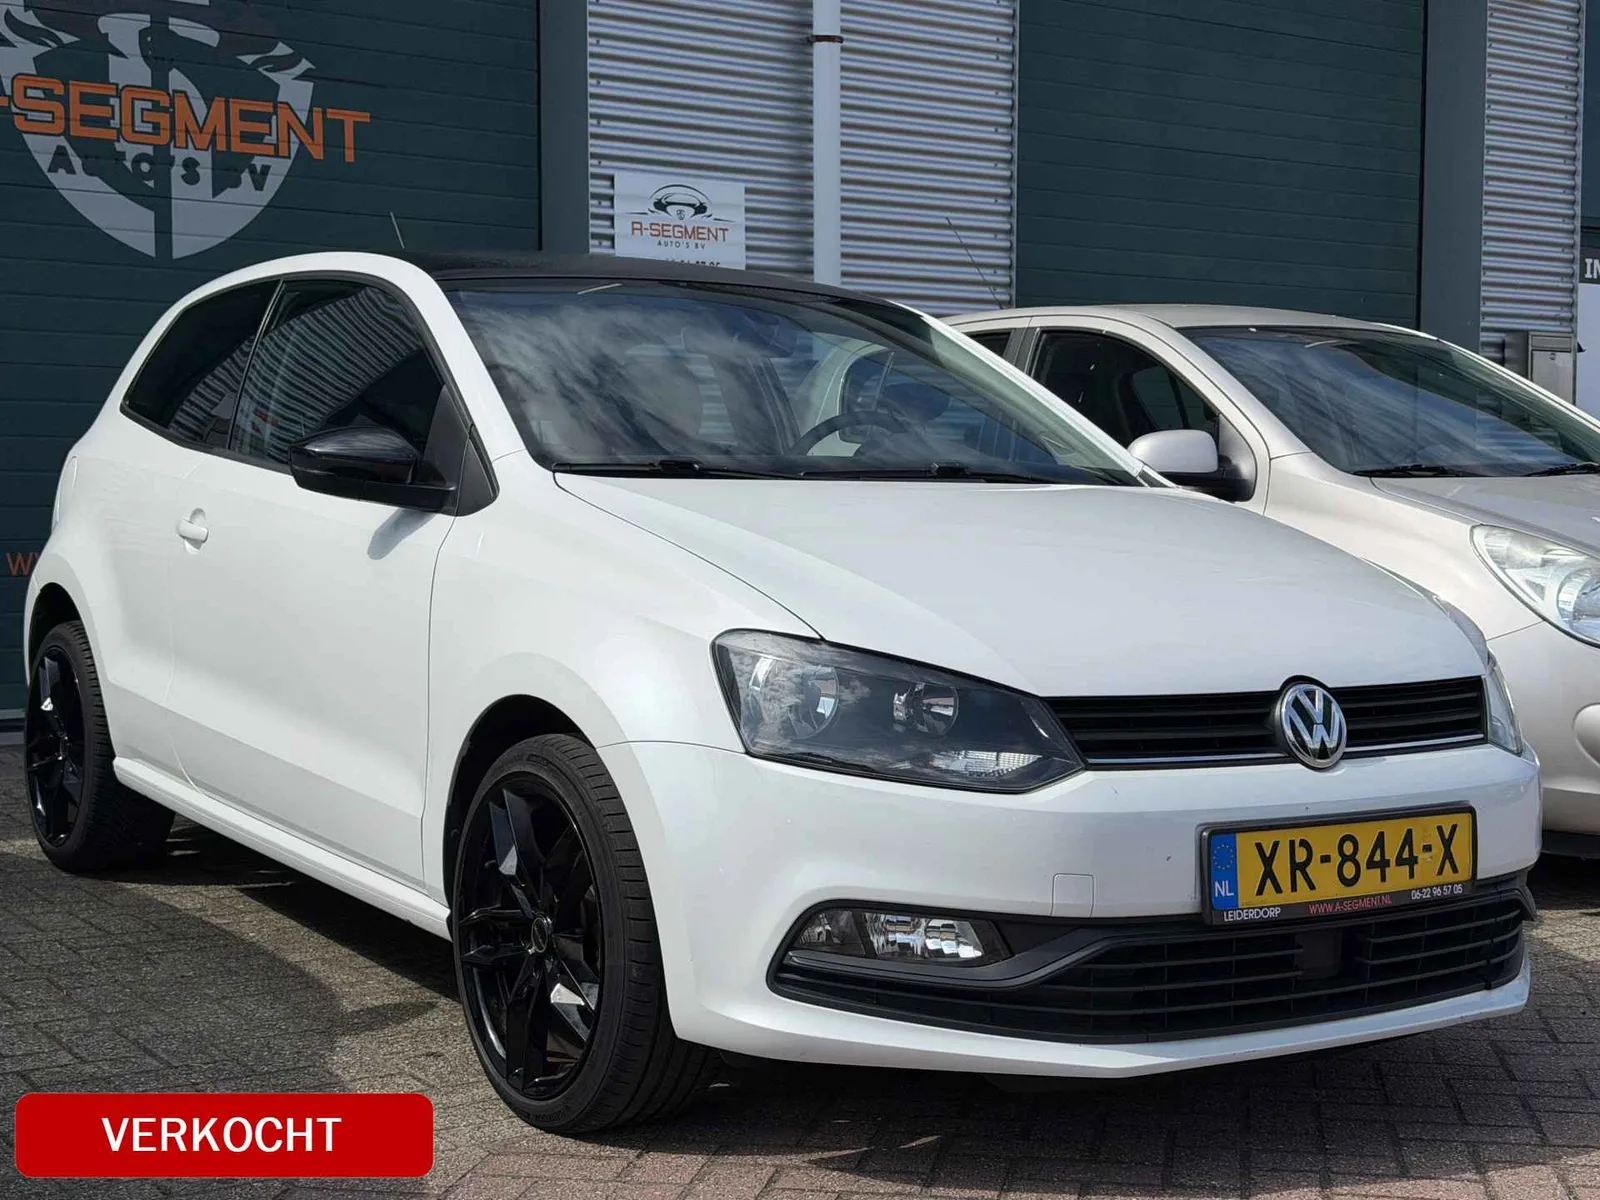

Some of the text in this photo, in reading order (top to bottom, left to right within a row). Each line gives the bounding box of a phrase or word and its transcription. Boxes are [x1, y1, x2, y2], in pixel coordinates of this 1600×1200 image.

[631, 221, 729, 242] A-SEGMENT
[657, 240, 706, 251] AUTO'S BV
[1254, 823, 1459, 896] XR-844-X
[1214, 880, 1235, 897] NL
[1411, 888, 1431, 900] 06-22
[1432, 886, 1442, 897] 96
[1443, 884, 1452, 895] 57
[1308, 894, 1392, 914] WWW.A-SEGMENT.NL
[1223, 906, 1281, 922] LEIDERDORP
